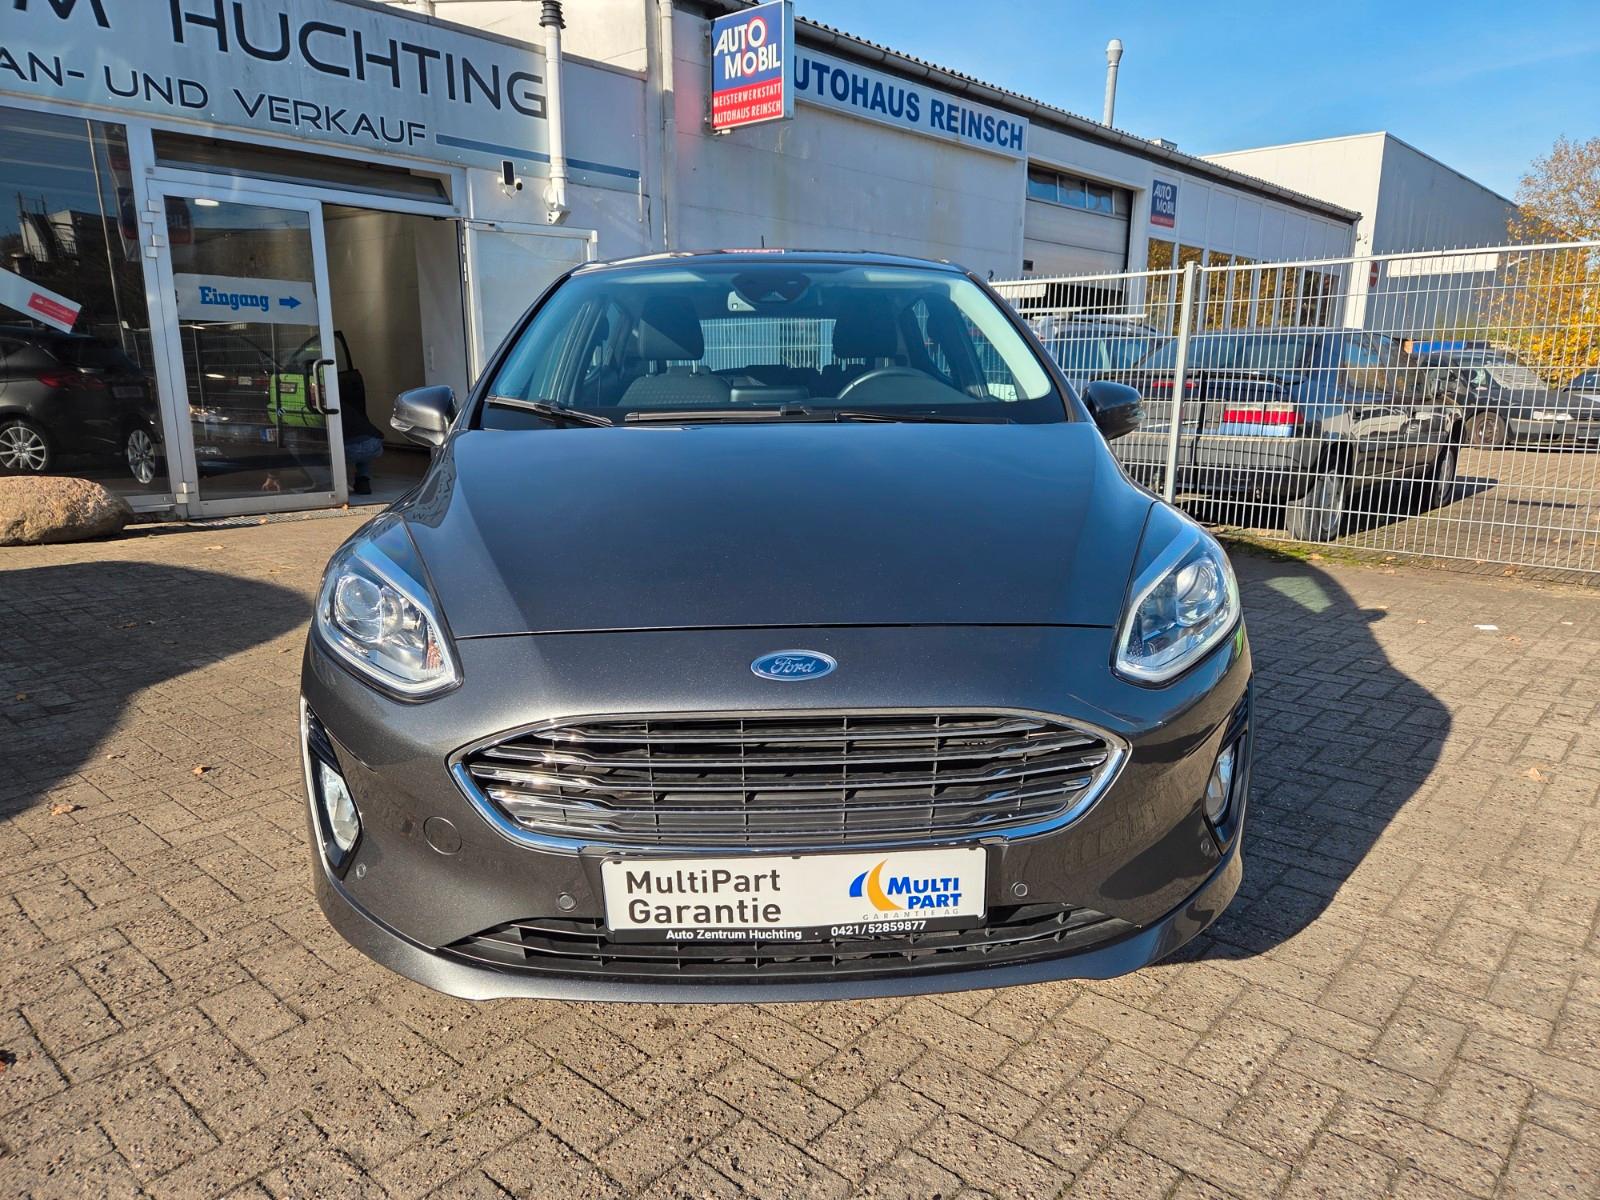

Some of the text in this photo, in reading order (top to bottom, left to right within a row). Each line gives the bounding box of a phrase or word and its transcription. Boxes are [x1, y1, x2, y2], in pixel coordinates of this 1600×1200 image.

[713, 18, 766, 56] AUTO
[168, 0, 548, 119] HUCHTING
[724, 43, 781, 80] MOBIL
[104, 65, 209, 109] UND
[233, 88, 426, 146] VERKAUF
[713, 82, 781, 107] MEISTERWERKSTATT
[794, 55, 1023, 151] UTOHAUS REINSCH
[713, 100, 781, 124] AUTOHAUS REINSCH
[1153, 183, 1172, 200] AUTO
[198, 286, 270, 312] Eingang
[770, 656, 816, 674] Ford
[626, 869, 781, 894] MultiPart
[887, 876, 960, 895] MULTI
[628, 897, 781, 924] Garantie
[908, 893, 962, 910] PART
[862, 909, 936, 921] GARANTIE
[666, 920, 927, 941] Auto Zentrum Huchting 0421/52859877
